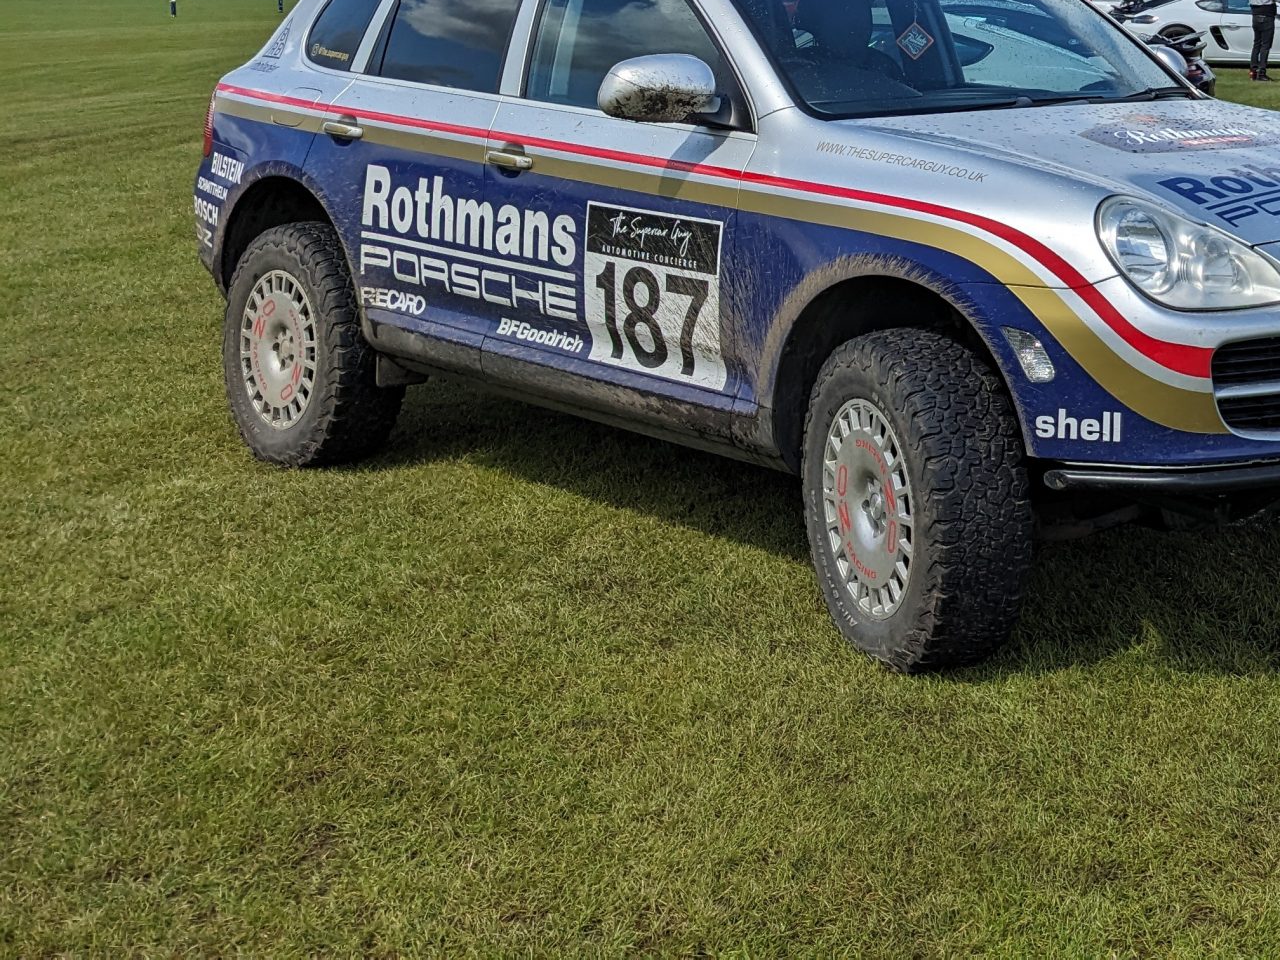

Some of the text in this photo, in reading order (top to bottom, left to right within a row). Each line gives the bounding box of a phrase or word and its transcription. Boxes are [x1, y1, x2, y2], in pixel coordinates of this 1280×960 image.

[211, 151, 245, 185] BILSTEIN
[816, 140, 990, 183] WWW.THESUPERCARGUY.CO.UK
[361, 163, 577, 267] Rothmans
[610, 211, 693, 257] The Supercar Guy
[601, 244, 698, 269] AUTOMOTIVE CONCIERGE
[360, 243, 578, 322] PORSCHE
[361, 286, 427, 316] RECARO
[496, 317, 584, 353] BFGoodrich
[596, 261, 709, 377] 187
[1035, 408, 1121, 442] shell
